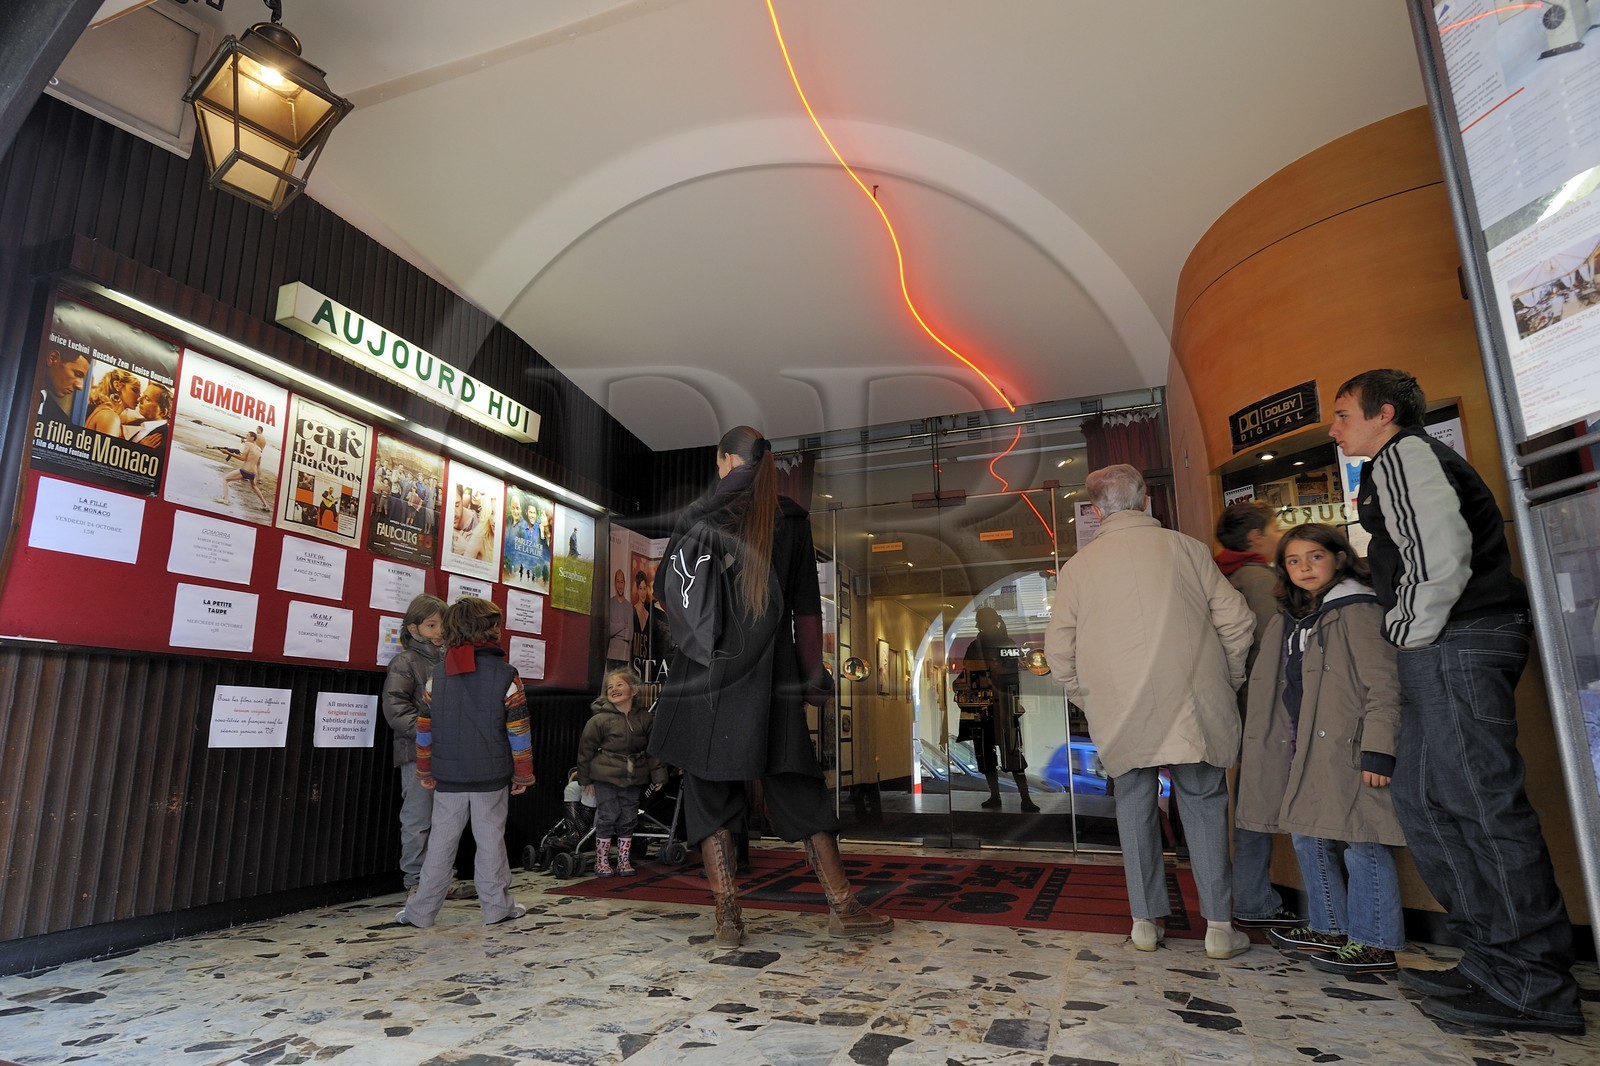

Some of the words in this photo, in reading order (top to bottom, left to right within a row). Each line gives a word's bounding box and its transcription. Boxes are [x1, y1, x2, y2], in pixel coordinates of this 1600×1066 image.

[1576, 309, 1600, 324] STUDI
[68, 339, 90, 355] Luchini
[92, 349, 117, 365] Roschdy
[117, 358, 129, 370] Zem
[131, 364, 149, 377] Louise
[190, 375, 275, 427] GOMORRA
[1264, 398, 1297, 418] DOLBY
[1240, 412, 1304, 442] DIGITAL
[34, 420, 44, 438] a
[46, 420, 72, 446] fille
[76, 429, 91, 452] de
[91, 434, 159, 478] Monaco
[322, 446, 348, 467] los
[293, 453, 362, 486] maestros
[84, 507, 111, 517] MONACO
[90, 500, 108, 509] FILLE
[201, 528, 230, 539] GOMORRA
[376, 522, 418, 545] FAUBOURG
[514, 536, 543, 550] PARLEZ-MOI
[514, 543, 522, 552] DE
[522, 545, 529, 554] LA
[530, 547, 543, 558] PLUIE
[1000, 648, 1020, 657] BAR
[634, 657, 670, 684] STA
